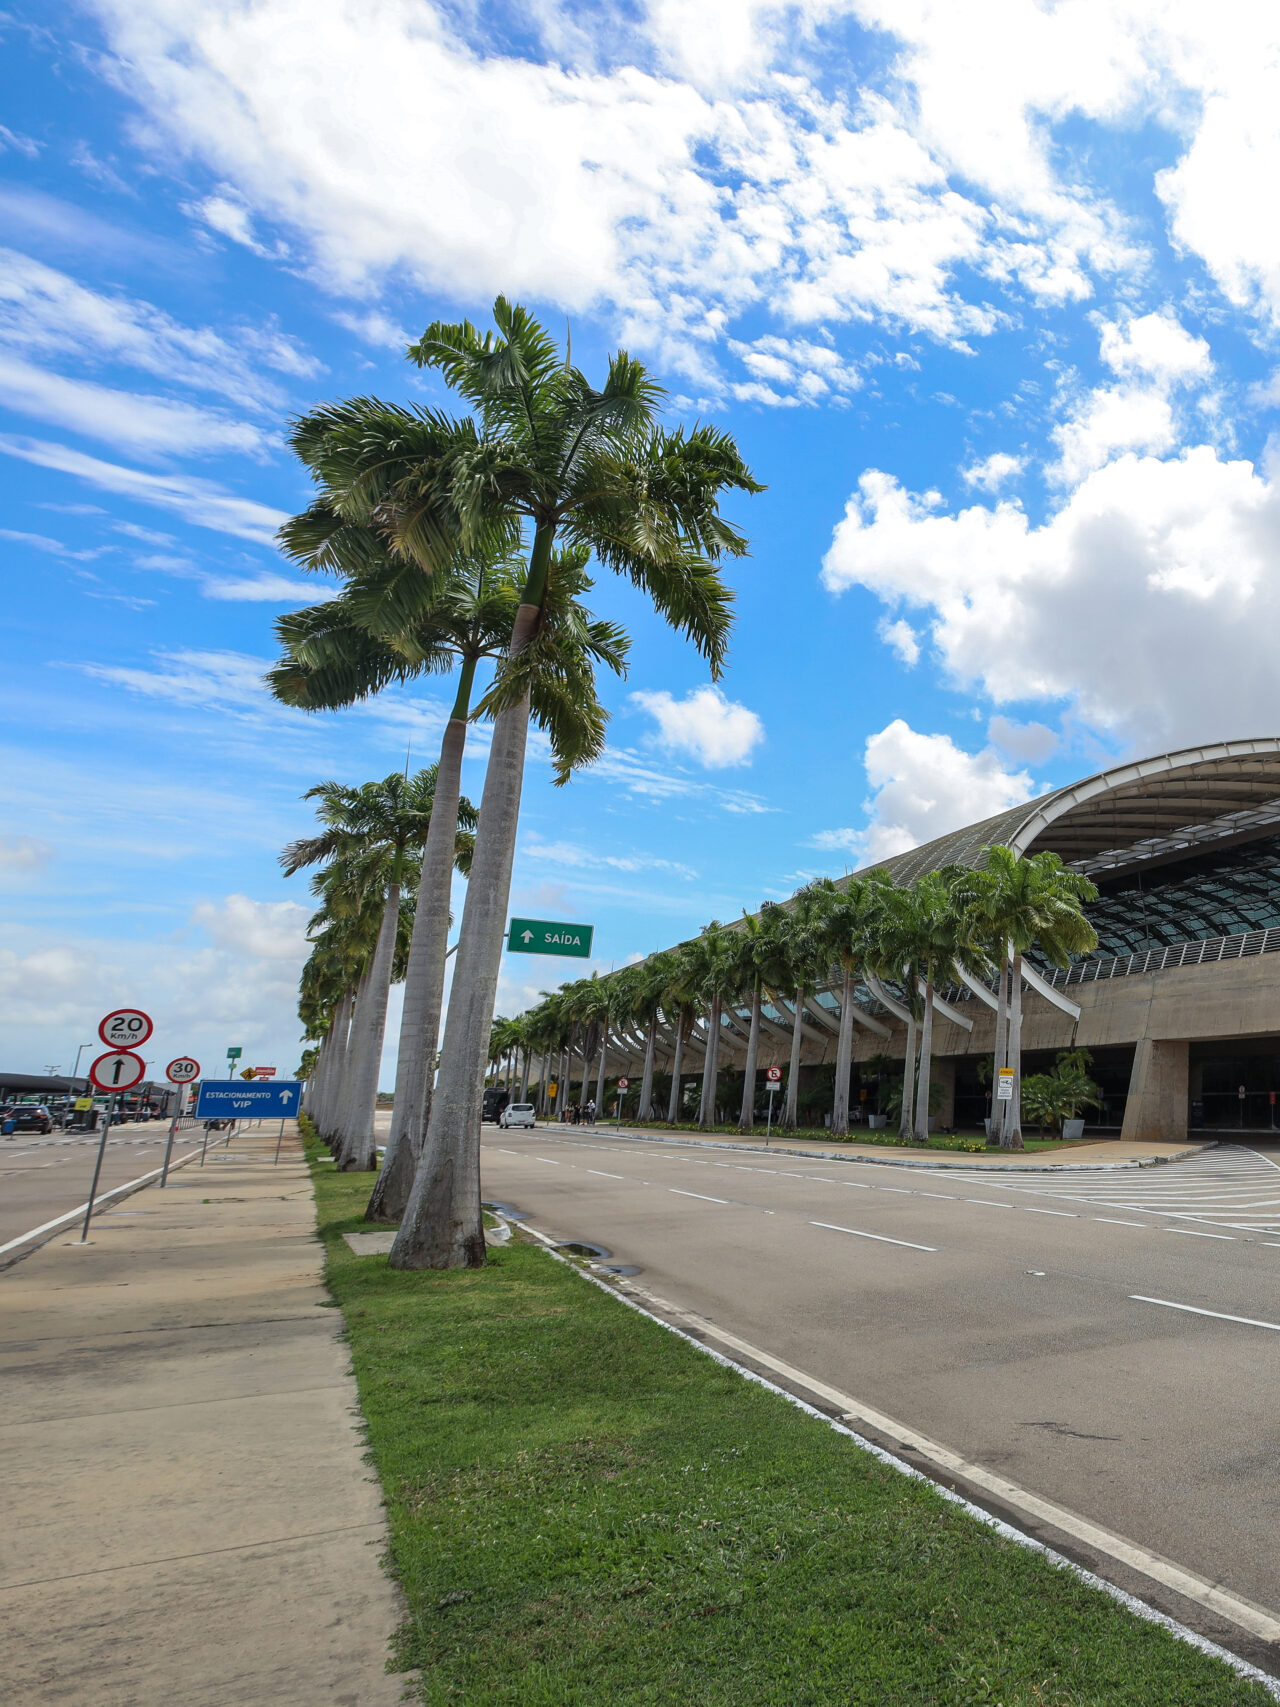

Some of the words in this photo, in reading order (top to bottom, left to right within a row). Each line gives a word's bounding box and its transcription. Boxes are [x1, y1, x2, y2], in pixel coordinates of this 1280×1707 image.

[544, 931, 581, 946] SAÍDA
[111, 1017, 143, 1031] 20
[173, 1063, 193, 1073] 30
[205, 1091, 271, 1099] ESTACIONAMENTO
